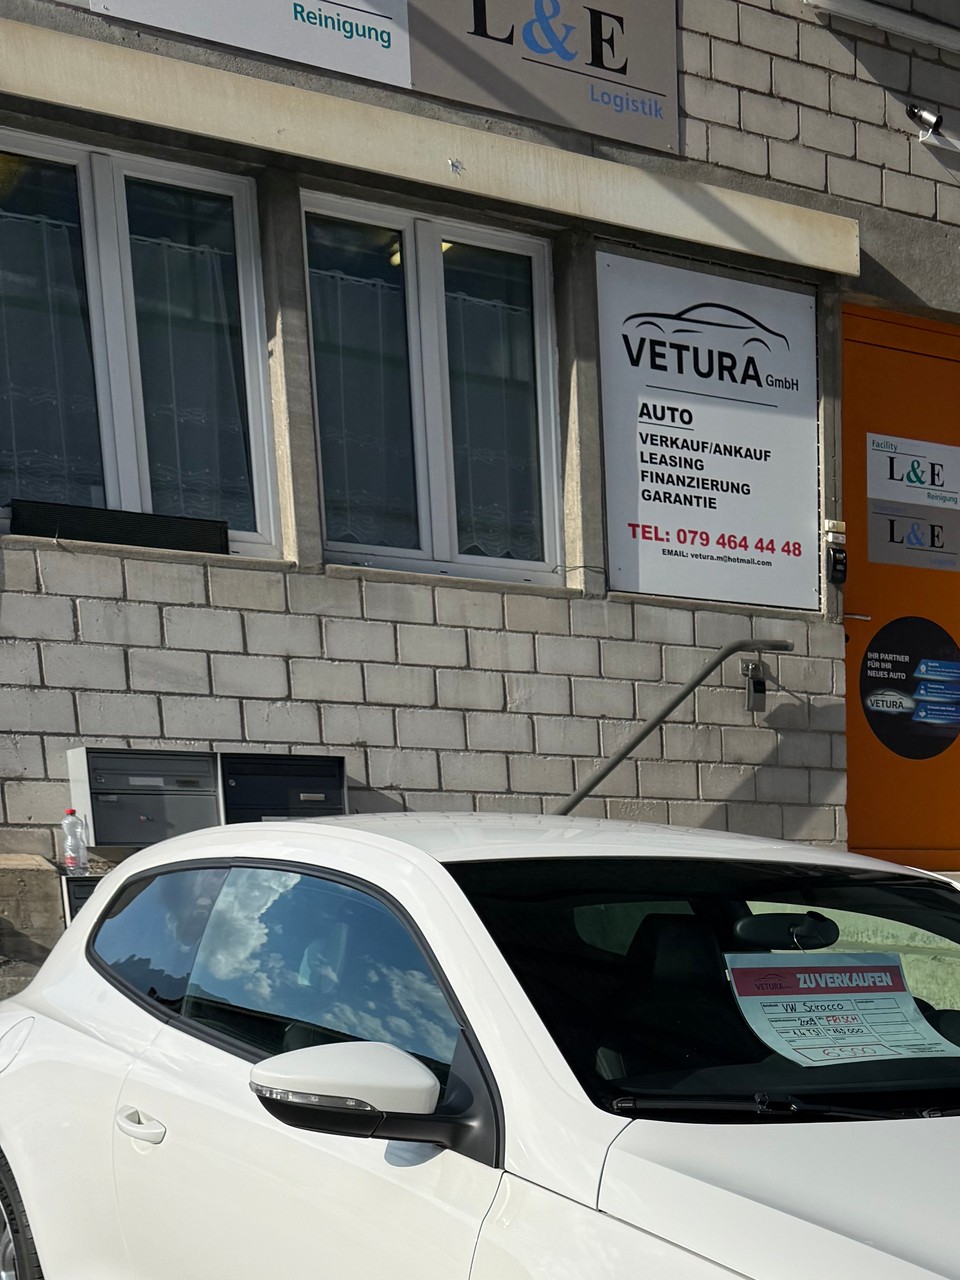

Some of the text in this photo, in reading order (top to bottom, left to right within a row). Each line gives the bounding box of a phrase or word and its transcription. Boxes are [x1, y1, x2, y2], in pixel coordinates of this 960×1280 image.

[293, 2, 391, 49] Reinigung
[467, 0, 628, 76] L&E
[590, 84, 664, 120] Logistik
[622, 334, 799, 391] VETURA GmbH
[638, 403, 693, 425] AUTO
[639, 432, 772, 461] VERKAUF/ANKAUF
[872, 439, 898, 452] Facility
[640, 451, 705, 471] LEASING
[887, 455, 944, 487] L&E
[640, 470, 751, 495] FINANZIERUNG
[641, 489, 717, 509] GARANTIE
[927, 492, 958, 504] Reinigung
[628, 523, 802, 557] TEL: 079 464 44 48
[888, 519, 944, 548] L&E
[662, 548, 689, 558] EMAIL:
[867, 660, 880, 668] FÜR
[880, 653, 910, 662] PARTNER
[867, 670, 906, 680] NEUES AUTO
[870, 699, 904, 709] VETURA
[754, 982, 784, 991] VETURA
[816, 972, 893, 988] VERKAUFEN
[781, 1002, 798, 1013] VW
[802, 1002, 844, 1012] Scirocco
[825, 1015, 859, 1024] FRISCH
